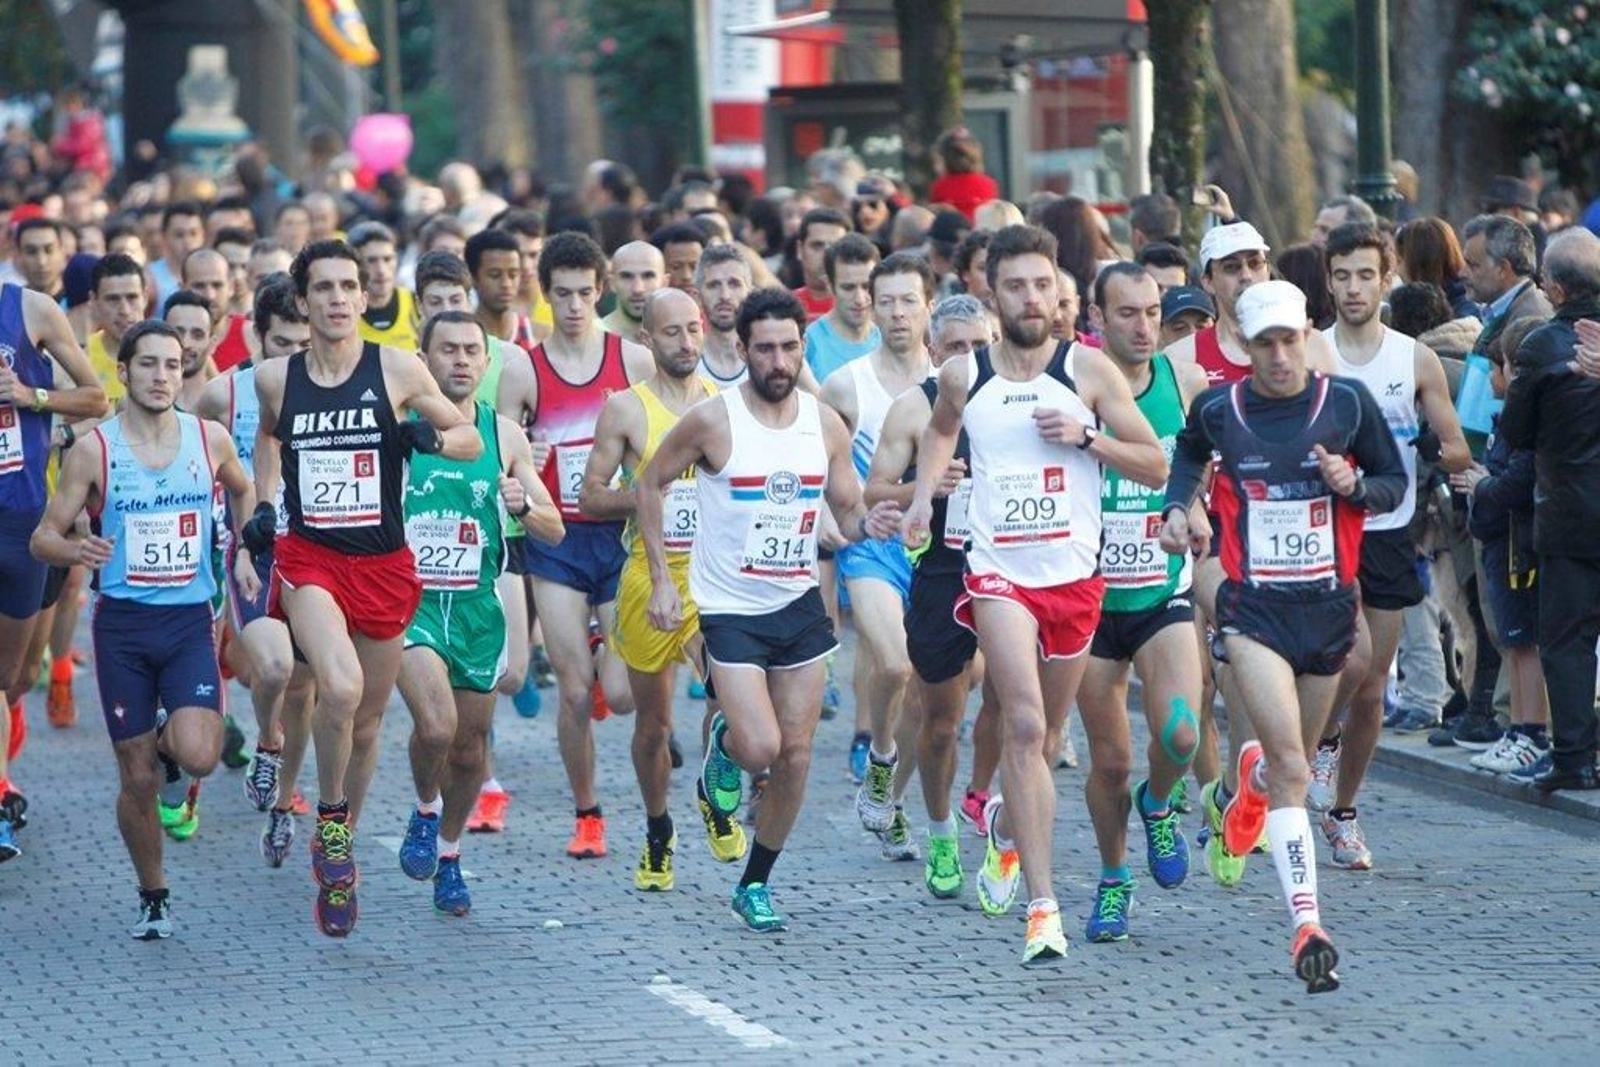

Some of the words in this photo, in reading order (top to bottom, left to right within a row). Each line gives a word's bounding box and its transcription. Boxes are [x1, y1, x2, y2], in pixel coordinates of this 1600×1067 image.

[292, 408, 378, 435] BIKILA
[291, 436, 332, 450] COMUNIDAD
[333, 432, 382, 445] CORREDORES
[306, 458, 349, 466] CONCELLO
[310, 466, 321, 474] DE
[570, 472, 584, 493] 2
[995, 473, 1038, 482] CONCELLO
[313, 481, 361, 504] 271
[115, 498, 148, 512] Celta
[1005, 496, 1056, 522] 209
[758, 512, 798, 523] CONCELLO
[1257, 508, 1303, 517] CONCELLO
[133, 519, 174, 527] CONCELLO
[413, 523, 455, 532] CONCELLO
[1103, 519, 1141, 527] ONCELLO
[151, 527, 169, 535] VIGO
[1116, 527, 1136, 535] VIGO
[762, 536, 805, 559] 314
[1269, 532, 1321, 557] 196
[144, 541, 191, 565] 514
[418, 545, 467, 568] 227
[1105, 542, 1154, 566] 395
[138, 564, 174, 573] CARREIRA
